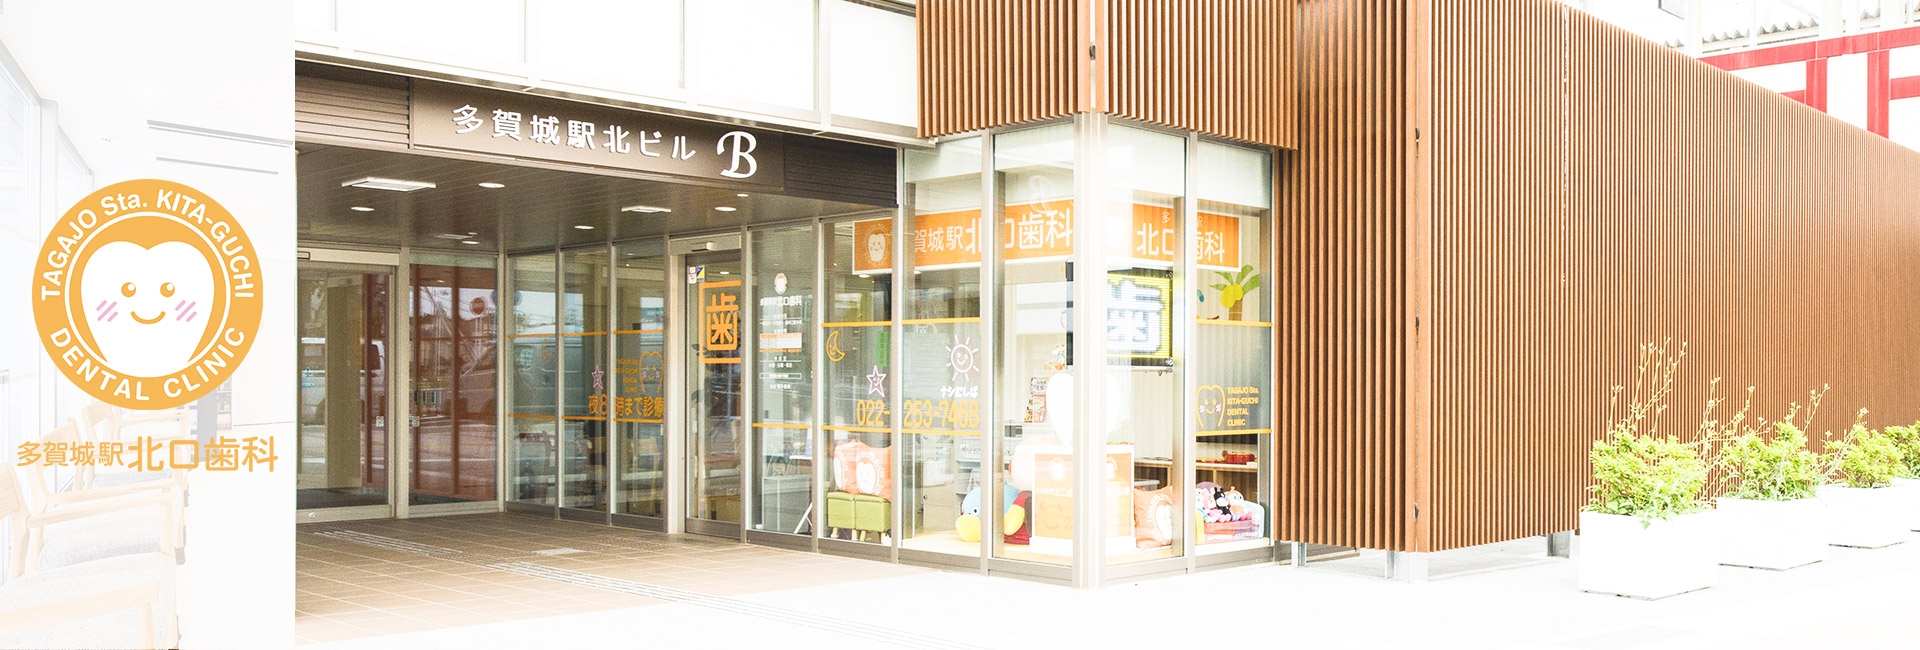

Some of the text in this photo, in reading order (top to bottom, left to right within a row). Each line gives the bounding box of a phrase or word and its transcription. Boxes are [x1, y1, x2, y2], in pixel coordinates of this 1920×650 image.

[451, 104, 758, 179] 多賀城駅北ビル B
[705, 292, 739, 351] 歯
[1227, 386, 1248, 395] TAGAJO
[1227, 408, 1249, 416] DENTAL
[1227, 419, 1246, 427] CLINIC
